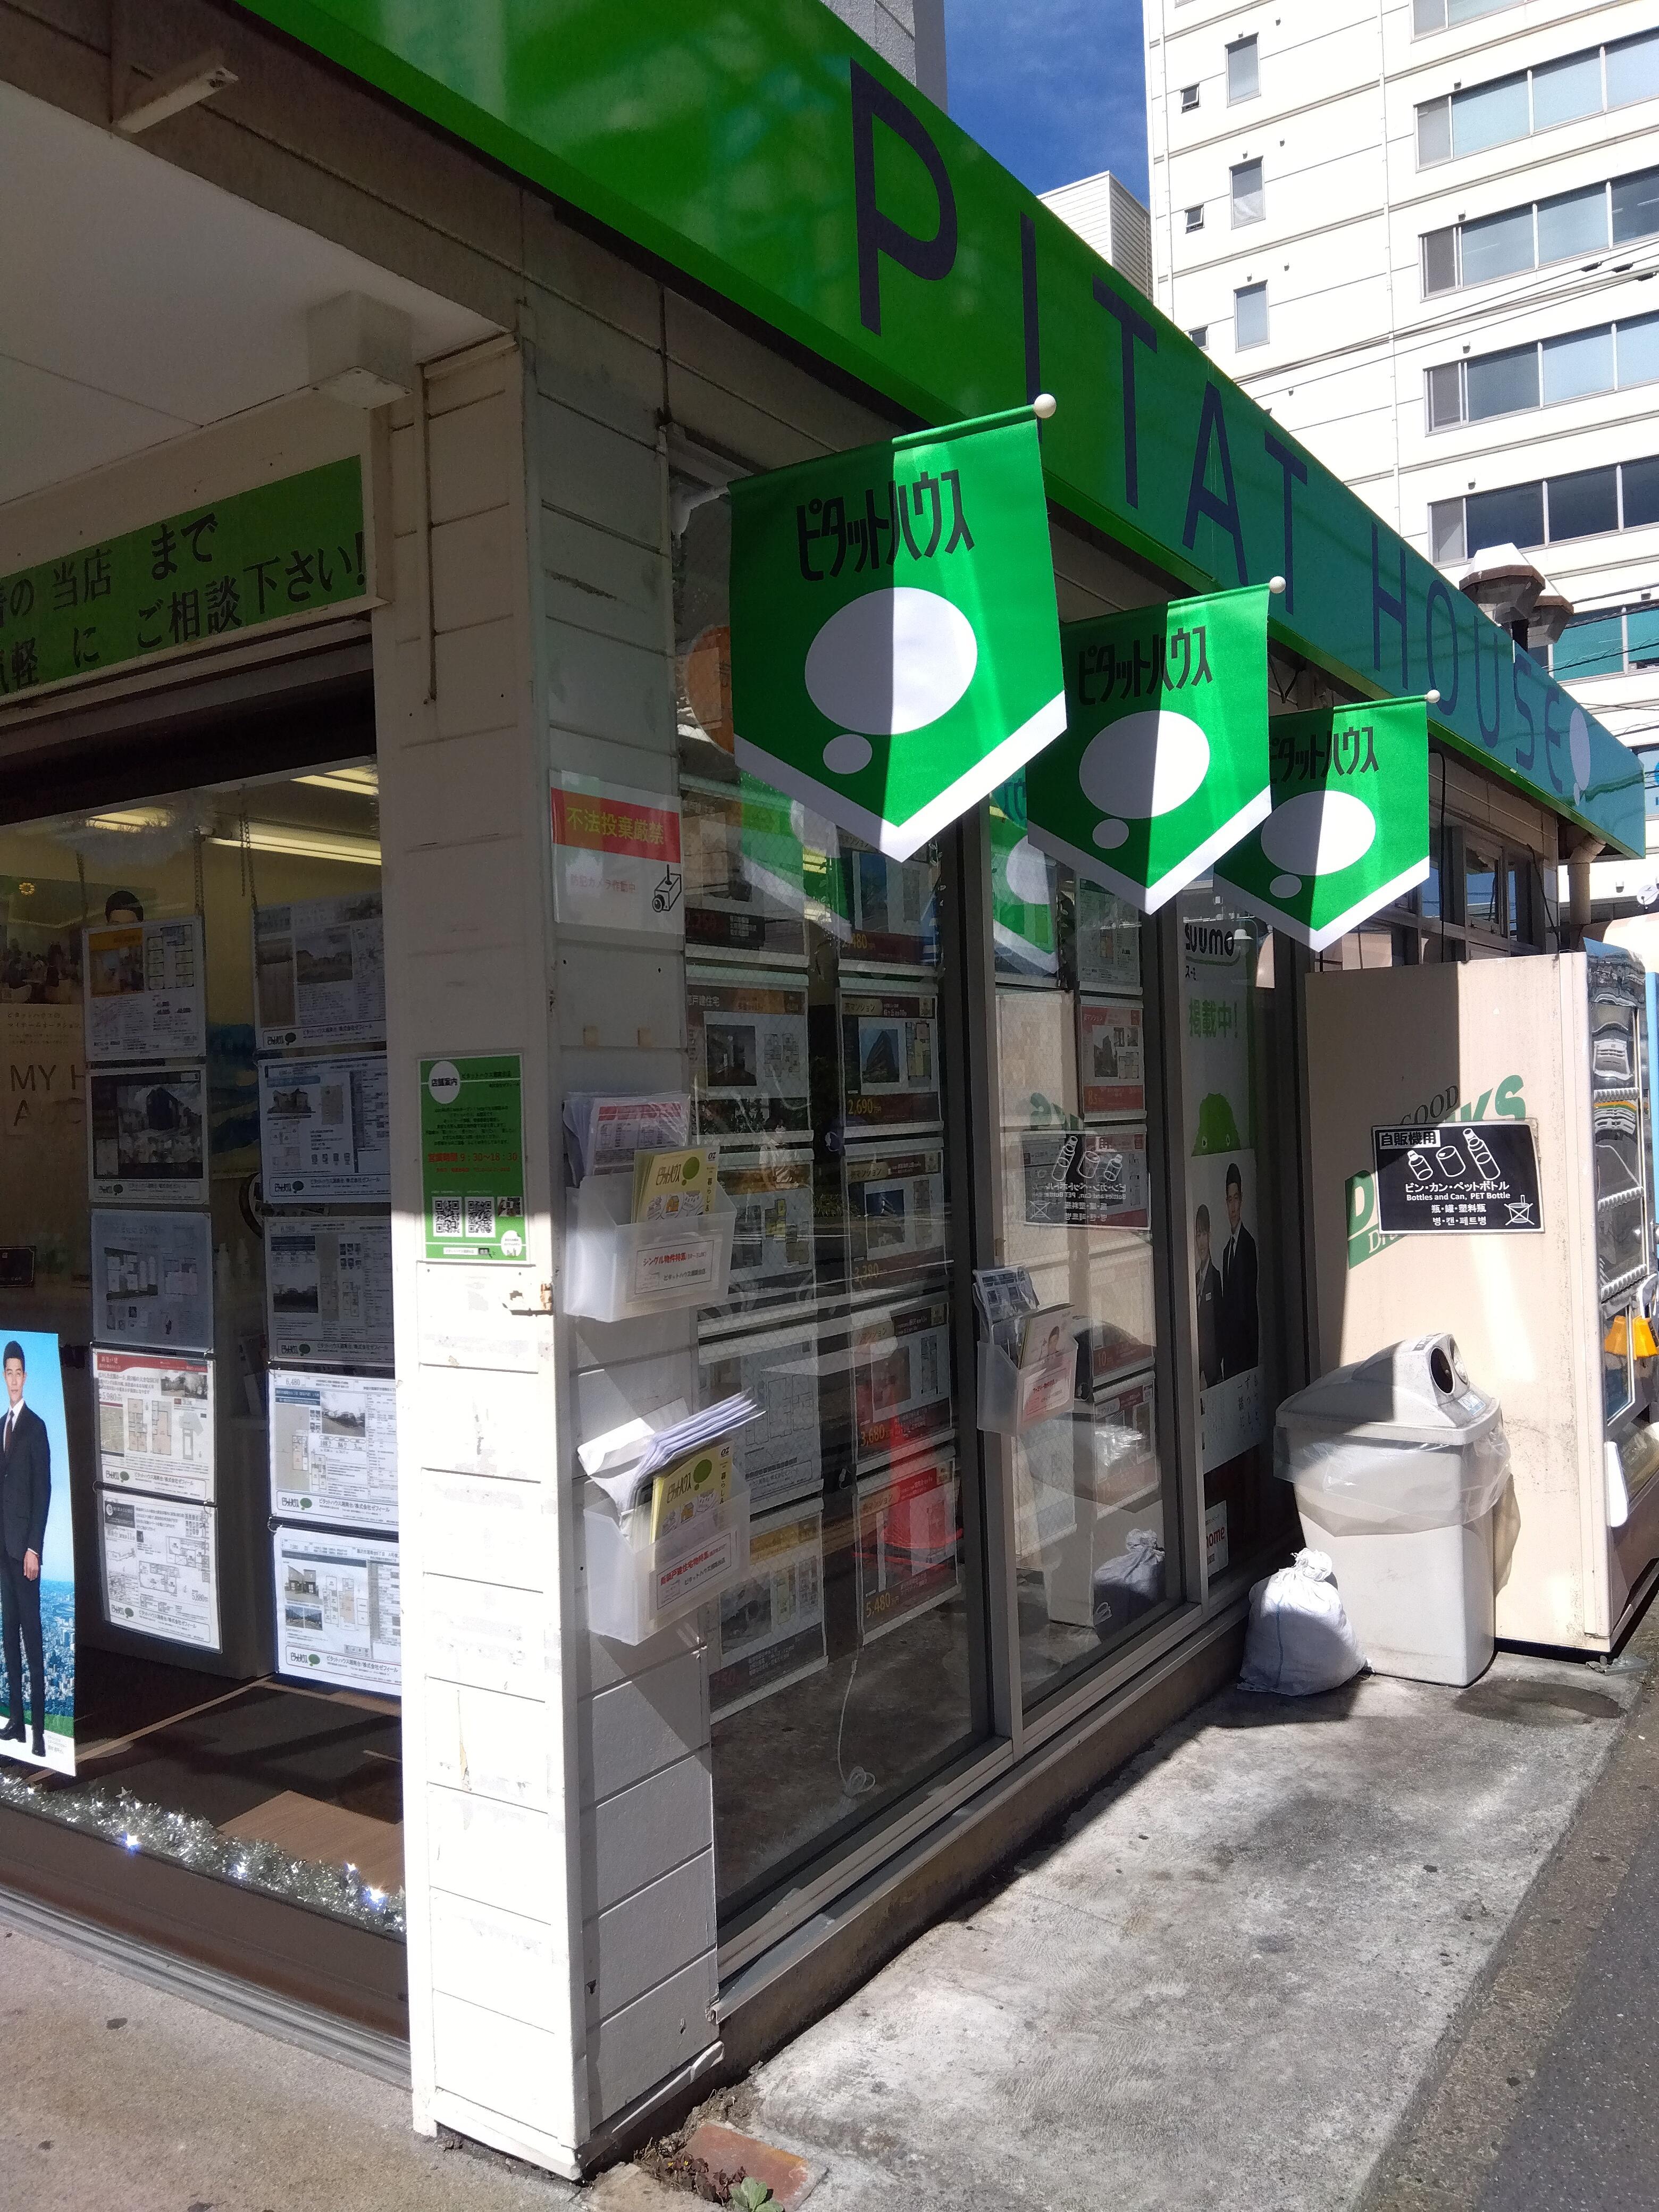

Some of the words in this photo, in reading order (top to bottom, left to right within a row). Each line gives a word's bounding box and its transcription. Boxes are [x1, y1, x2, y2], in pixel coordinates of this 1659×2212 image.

[851, 57, 1309, 615] PITAT
[1371, 523, 1563, 795] HOUSE
[797, 470, 975, 581] ピタットハウス
[0, 578, 34, 629] の
[52, 548, 112, 611] 当店
[151, 513, 218, 581] まで
[1078, 626, 1212, 705] ピタットハウス
[566, 807, 664, 845] 不法投棄厳禁
[10, 1065, 56, 1091] MY
[1381, 1132, 1437, 1146] 自販機用
[1405, 1181, 1510, 1193] ビン・カン・ペットボトル
